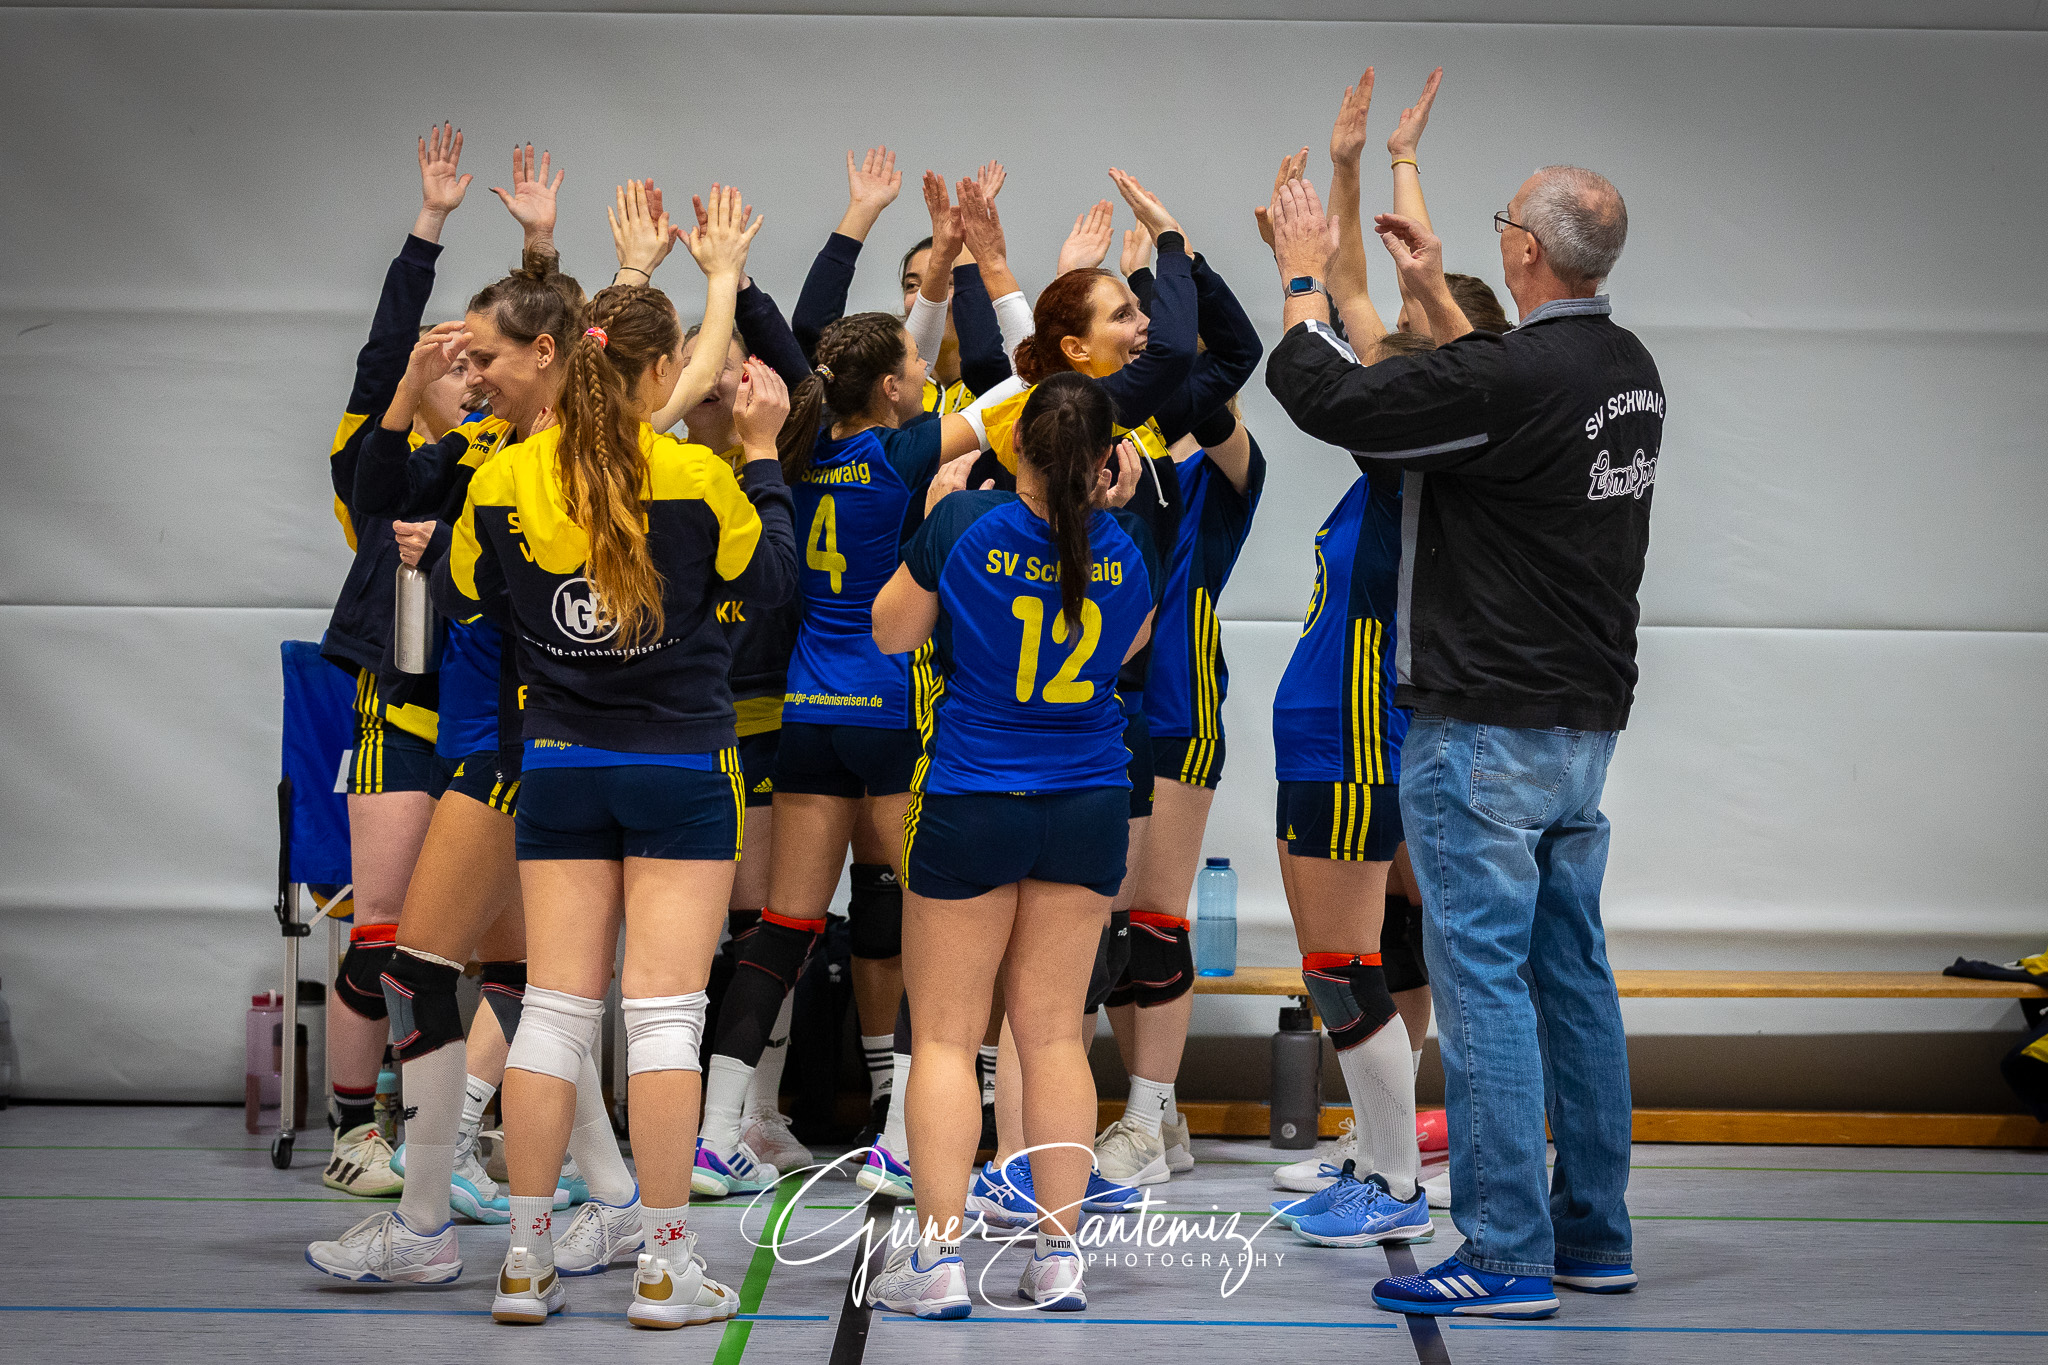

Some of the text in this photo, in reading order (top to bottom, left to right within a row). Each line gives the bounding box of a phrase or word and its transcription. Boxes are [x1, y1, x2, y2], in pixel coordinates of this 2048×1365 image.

[1585, 405, 1604, 440] SV
[805, 493, 847, 595] 4
[985, 549, 1123, 586] SV Scaig
[1011, 595, 1103, 704] 12
[1045, 1238, 1071, 1249] PUMA
